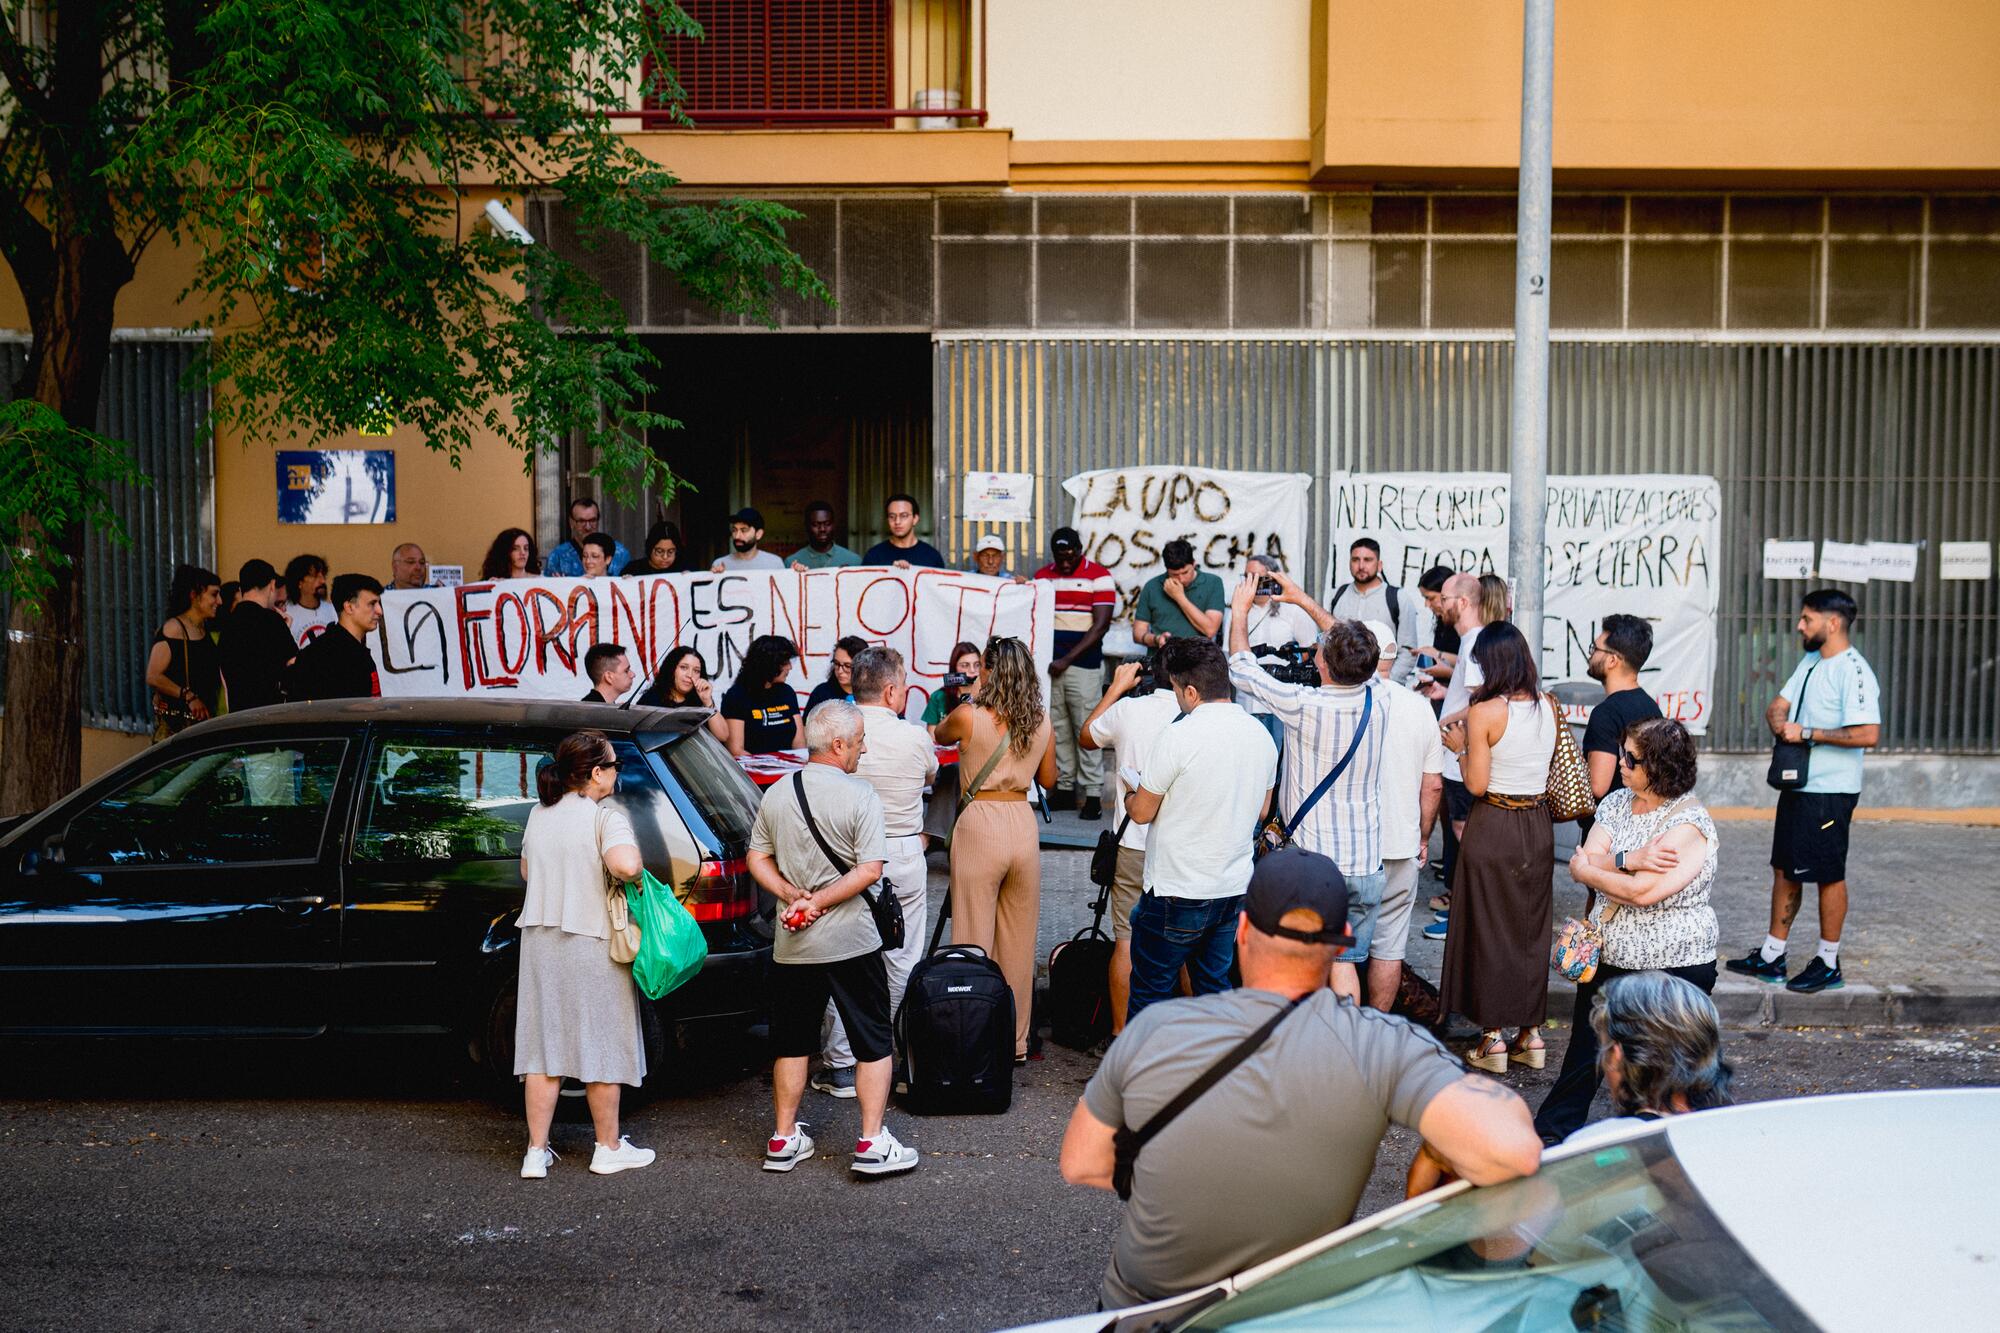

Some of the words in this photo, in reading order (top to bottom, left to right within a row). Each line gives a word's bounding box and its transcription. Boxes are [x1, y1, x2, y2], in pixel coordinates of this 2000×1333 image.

[1530, 275, 1544, 296] 2
[1080, 475, 1130, 518] LA
[1141, 473, 1231, 522] UPO
[1337, 484, 1366, 529] NI
[1378, 484, 1507, 531] RECORTES
[1545, 485, 1717, 531] PRIVATIZACIONES
[1558, 541, 1590, 587] SE
[1595, 535, 1709, 588] CIERRA
[378, 600, 450, 685] LA
[454, 583, 599, 690] FLORA
[610, 577, 680, 681] NO
[691, 576, 753, 629] ES
